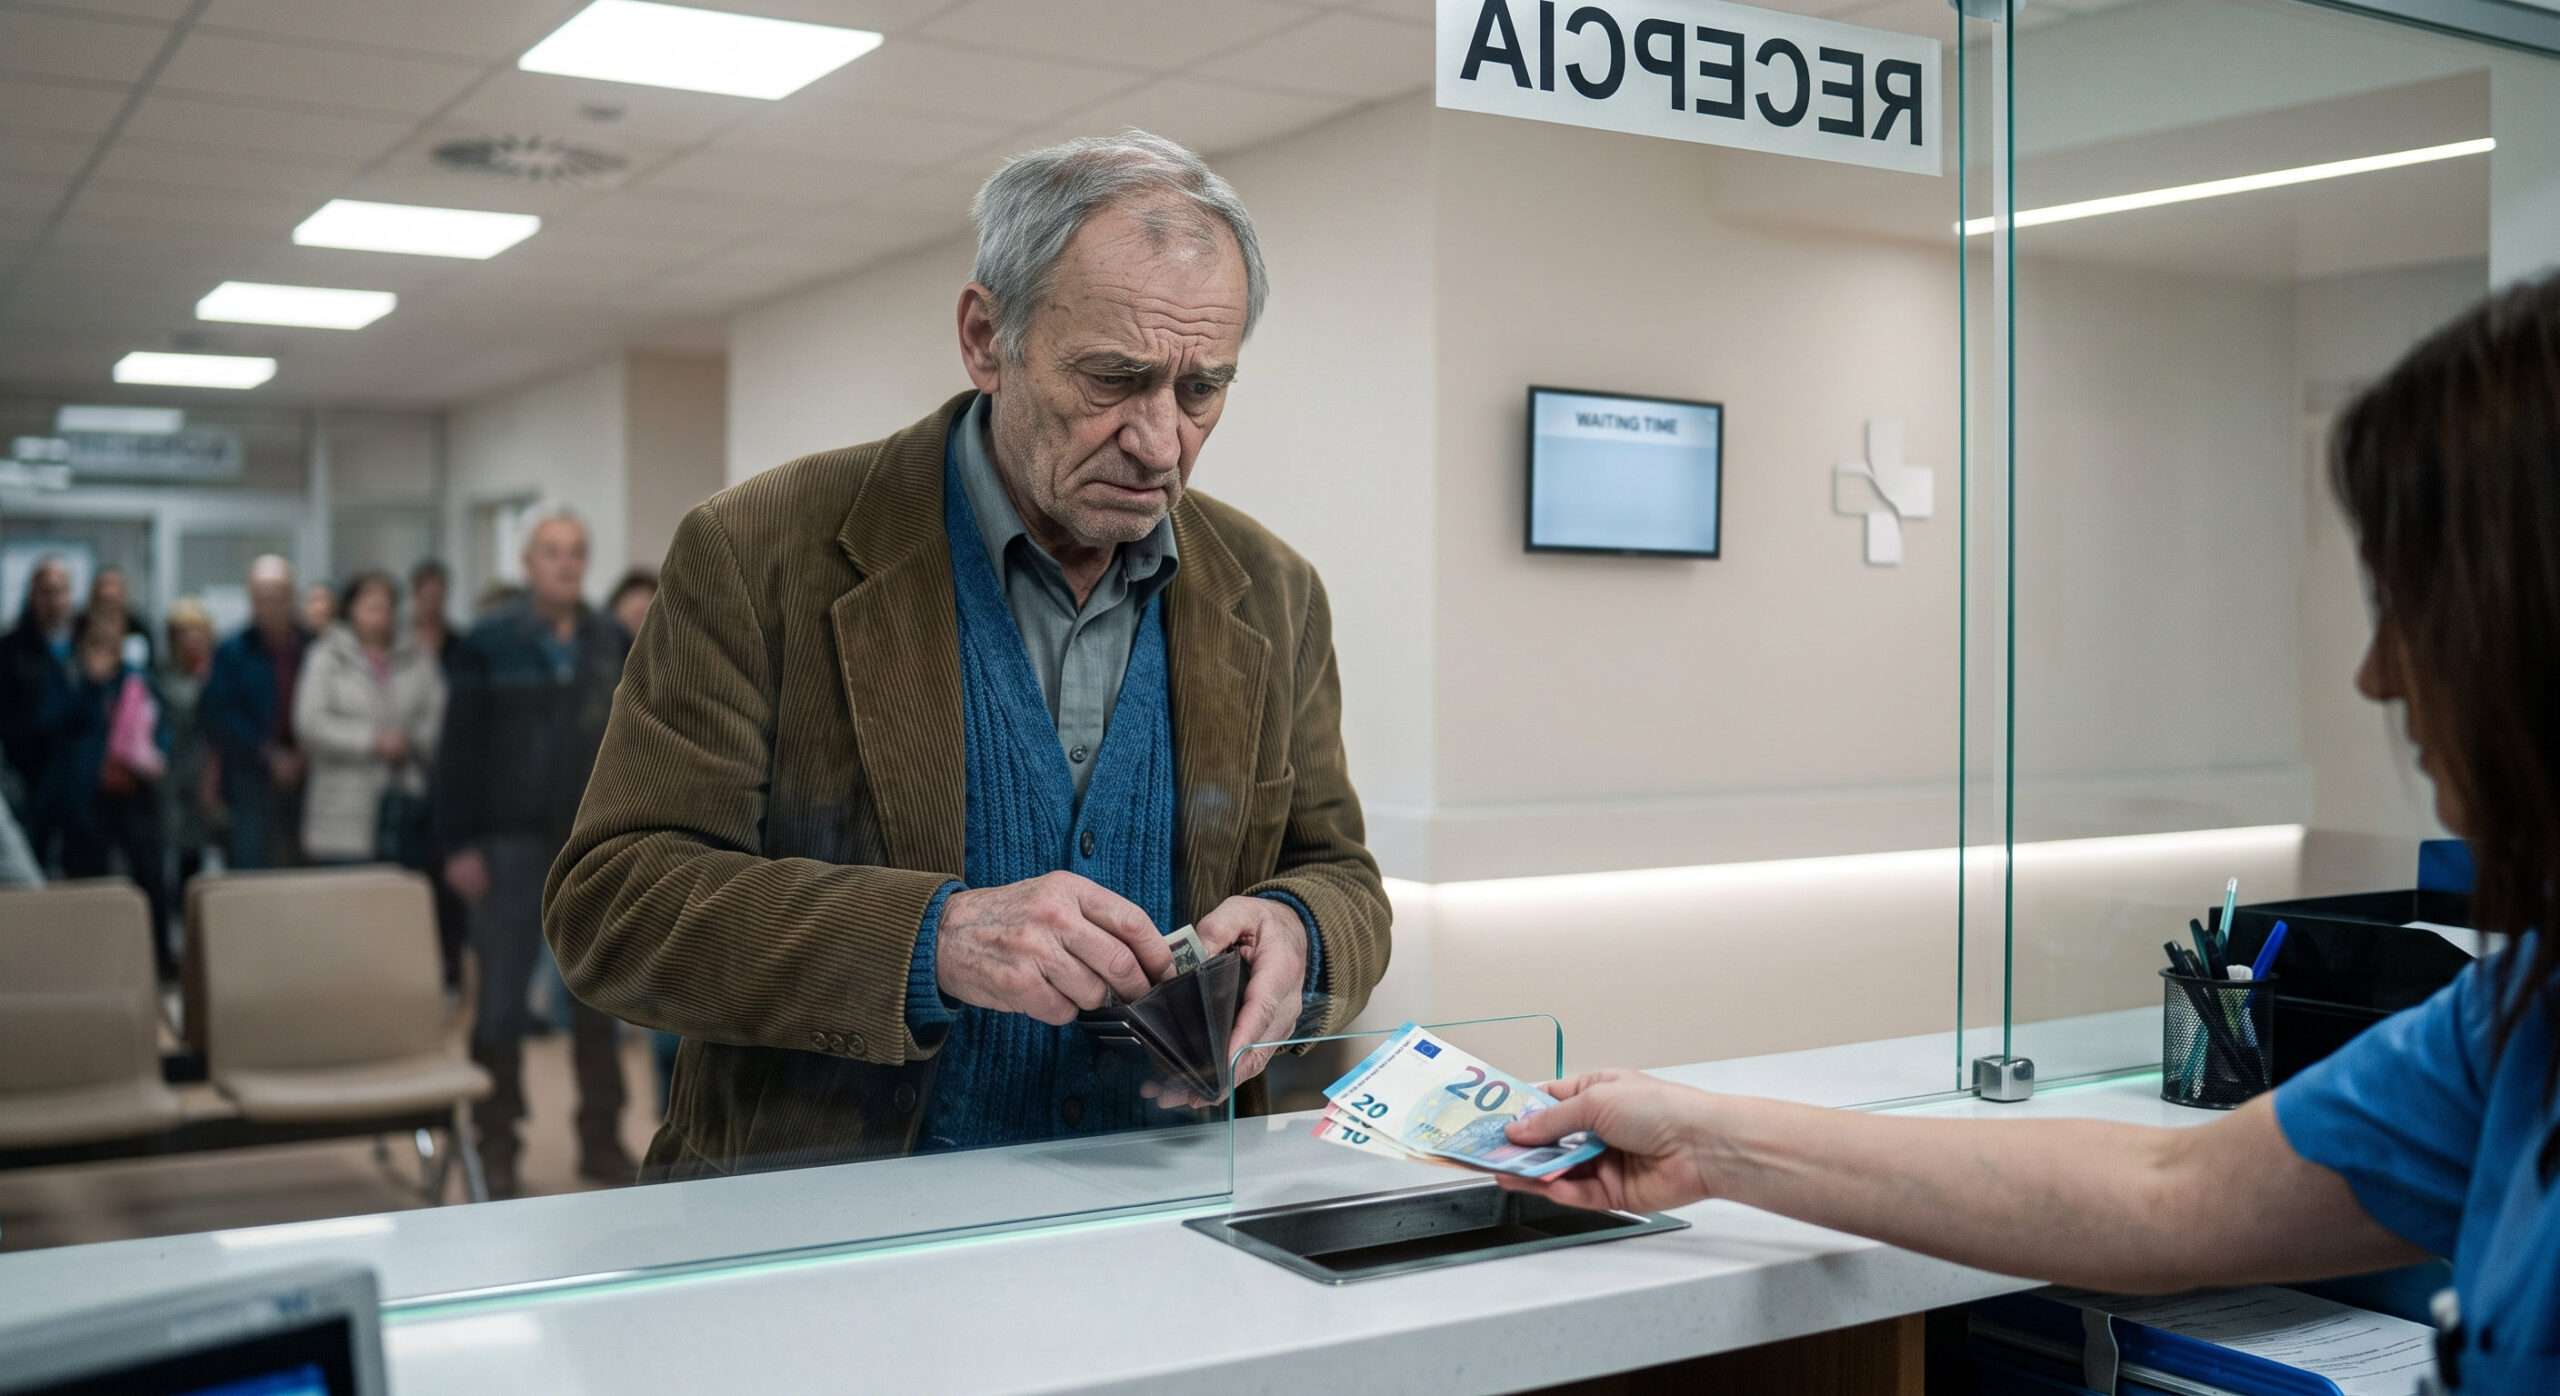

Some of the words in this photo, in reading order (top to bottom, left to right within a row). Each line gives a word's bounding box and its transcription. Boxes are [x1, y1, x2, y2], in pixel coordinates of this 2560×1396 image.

[1576, 412, 1639, 431] WAITING
[1644, 416, 1677, 434] TIME
[1445, 1066, 1511, 1112] 20
[1351, 1093, 1389, 1119] 20
